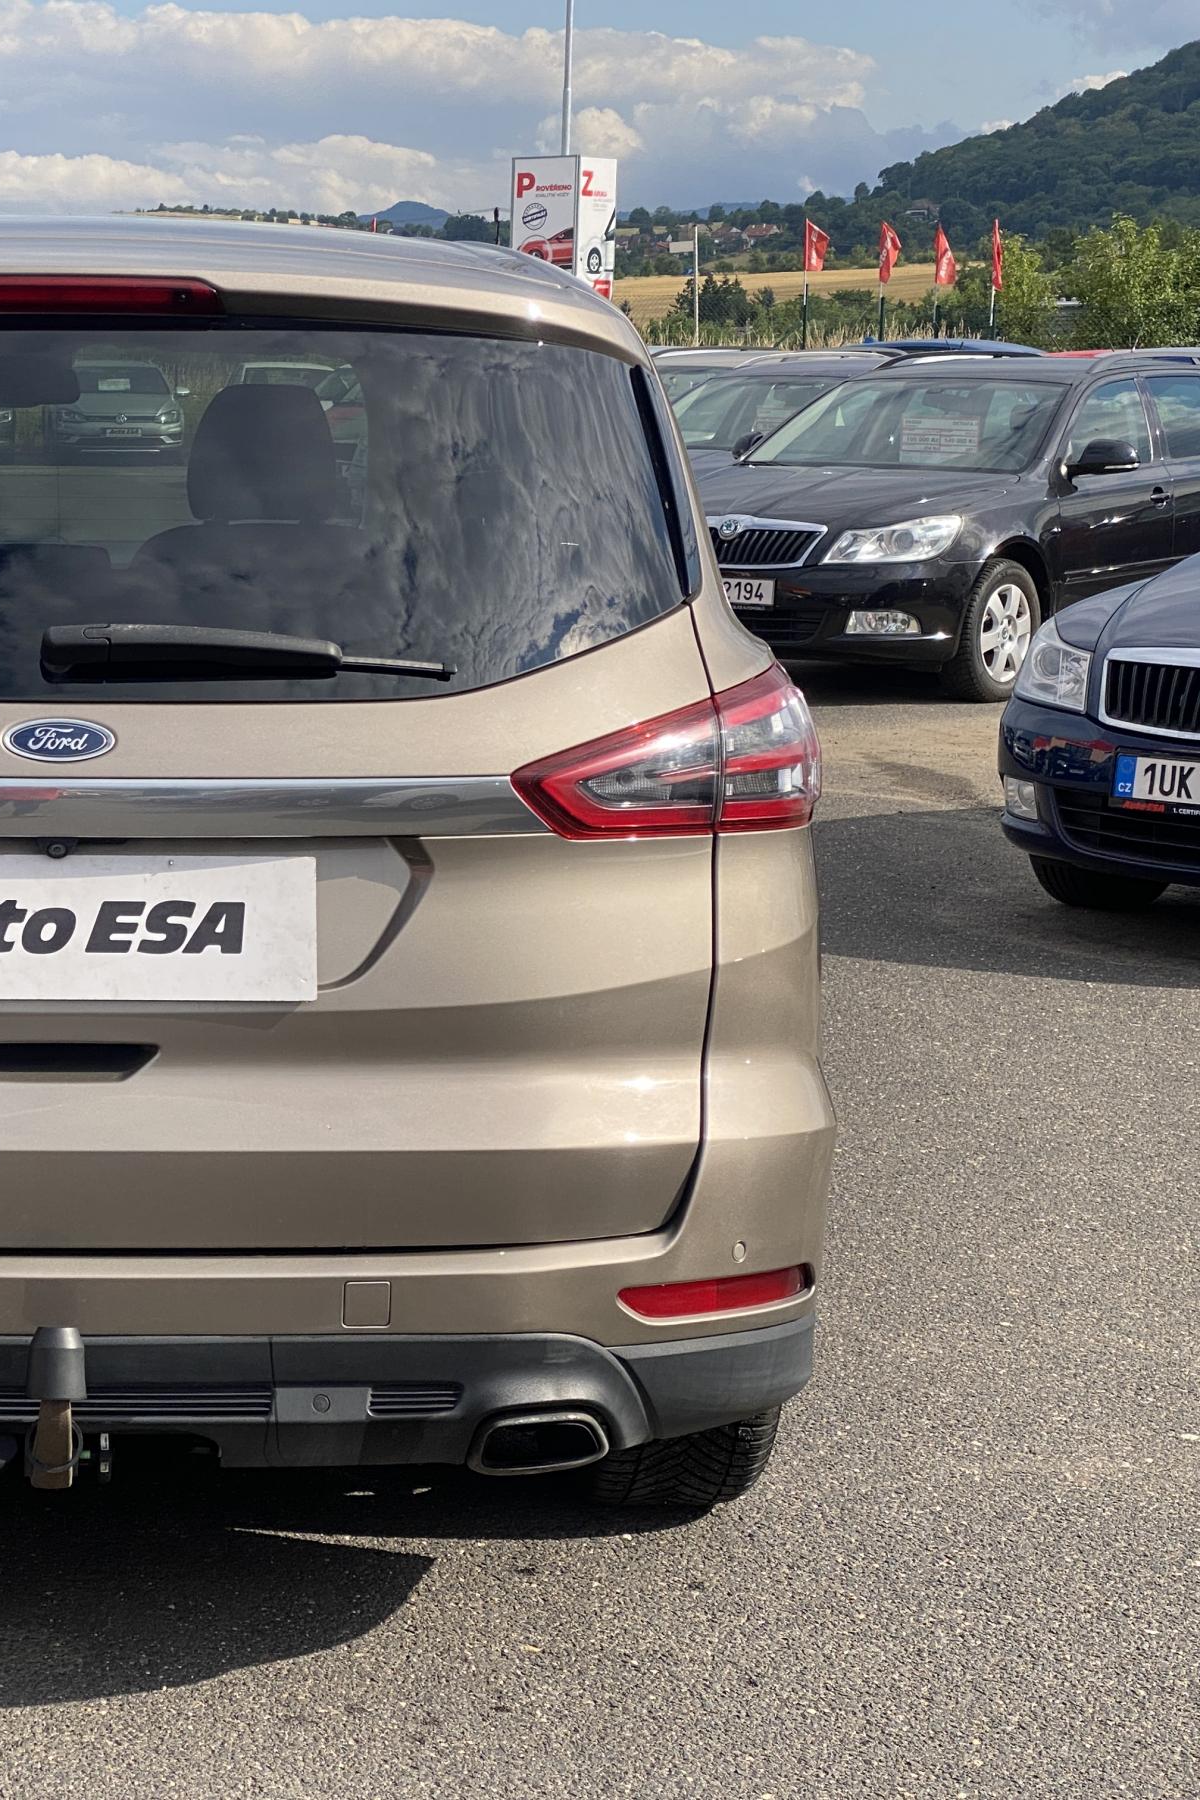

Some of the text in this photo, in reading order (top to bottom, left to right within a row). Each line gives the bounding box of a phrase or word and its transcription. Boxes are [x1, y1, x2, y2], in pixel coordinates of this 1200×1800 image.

[27, 726, 89, 751] Ford
[1118, 782, 1132, 793] CZ
[1143, 763, 1196, 800] 1UK
[84, 899, 246, 955] ESA
